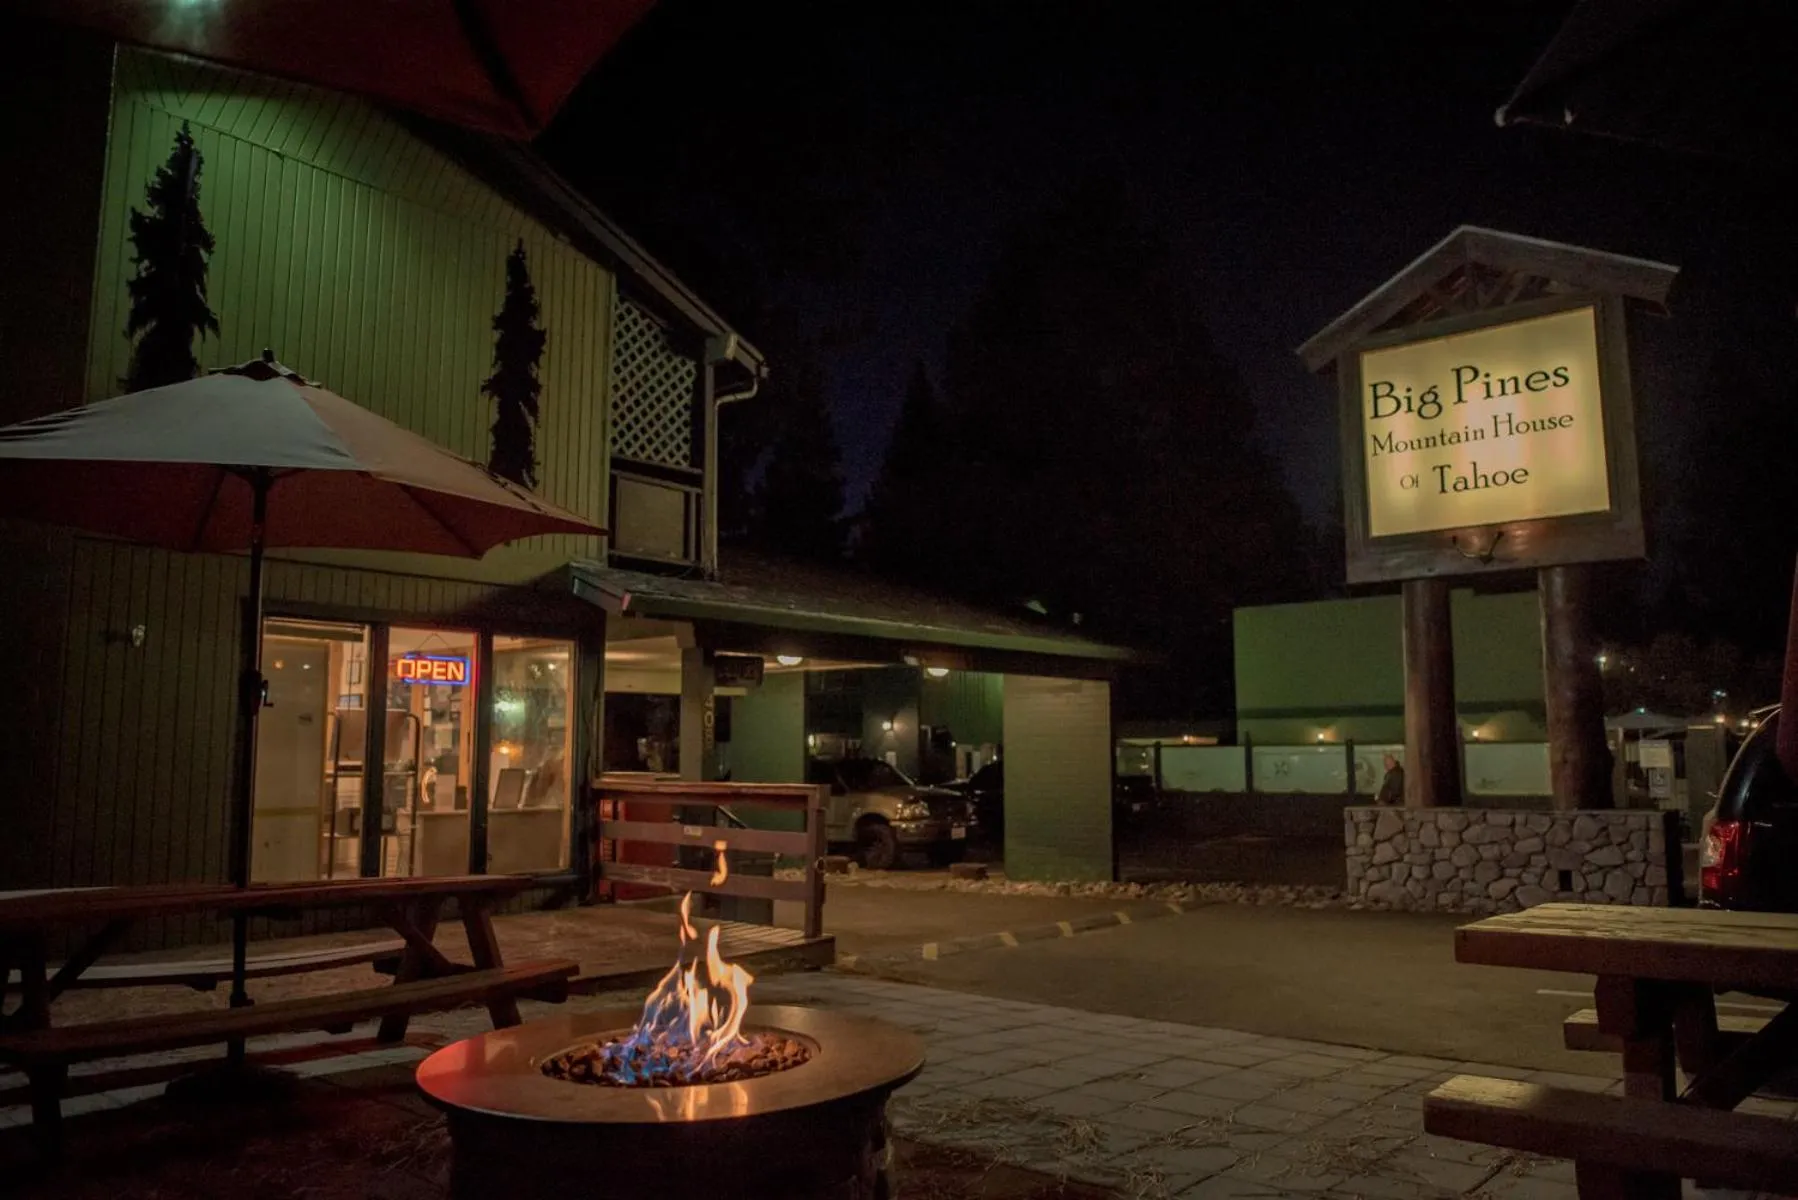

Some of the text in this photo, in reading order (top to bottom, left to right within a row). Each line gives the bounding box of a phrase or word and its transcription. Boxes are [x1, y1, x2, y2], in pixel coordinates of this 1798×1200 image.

[1368, 365, 1570, 420] Big Pines
[1371, 412, 1574, 457] Mountain House
[1432, 461, 1530, 494] Tahoe
[397, 658, 465, 681] OPEN
